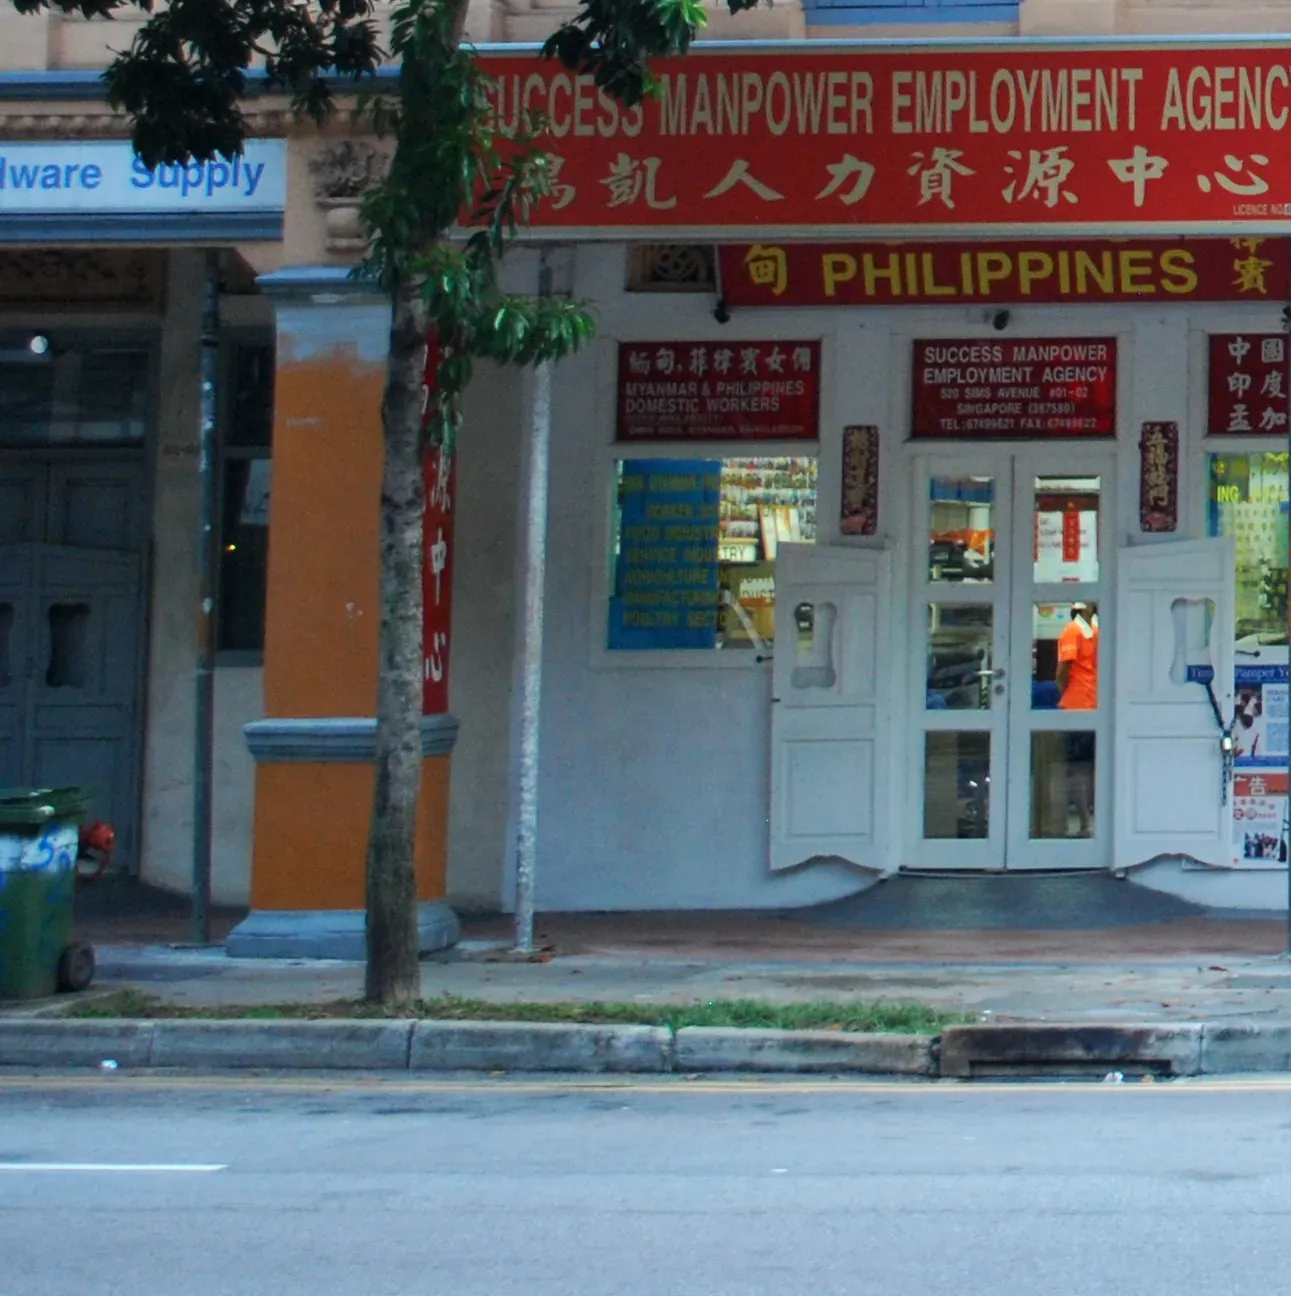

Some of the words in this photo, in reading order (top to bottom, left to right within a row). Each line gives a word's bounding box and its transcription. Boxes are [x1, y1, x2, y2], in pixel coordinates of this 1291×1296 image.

[659, 70, 874, 136] MANPOWER
[891, 67, 1144, 134] EMPLOYMENT
[131, 153, 265, 197] Supply
[822, 248, 1198, 297] PHILIPPINES
[924, 346, 1003, 364] SUCCESS
[1012, 344, 1107, 362] MANPOWER
[1228, 336, 1284, 365] 中國
[923, 366, 1034, 384] EMPLOYMENT
[1041, 365, 1108, 383] AGENCY
[1227, 370, 1287, 398] 印度
[625, 381, 698, 396] MYANMAR
[716, 380, 805, 395] PHILIPPINES
[964, 387, 992, 399] SIMS
[997, 386, 1041, 399] AVENUE
[625, 397, 700, 413] DOMESTIC
[706, 396, 780, 412] WORKERS
[956, 402, 1022, 415] SINGAPORE
